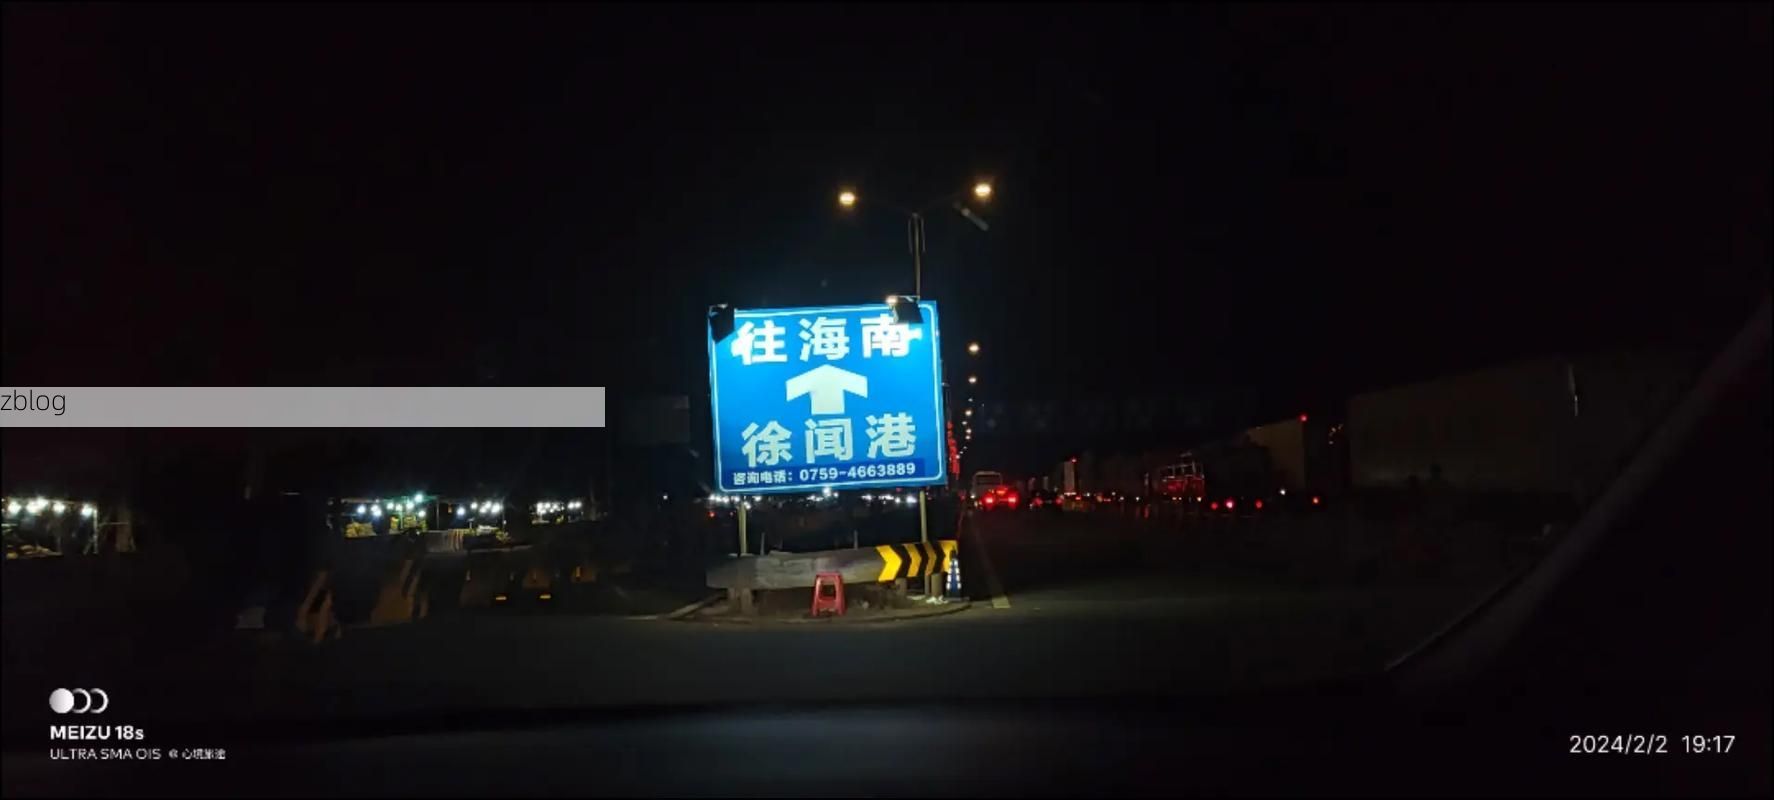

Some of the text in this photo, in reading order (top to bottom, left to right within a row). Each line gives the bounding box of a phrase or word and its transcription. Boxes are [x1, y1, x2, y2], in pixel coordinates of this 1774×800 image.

[731, 314, 914, 365] 往海南
[741, 412, 917, 468] 徐闻港
